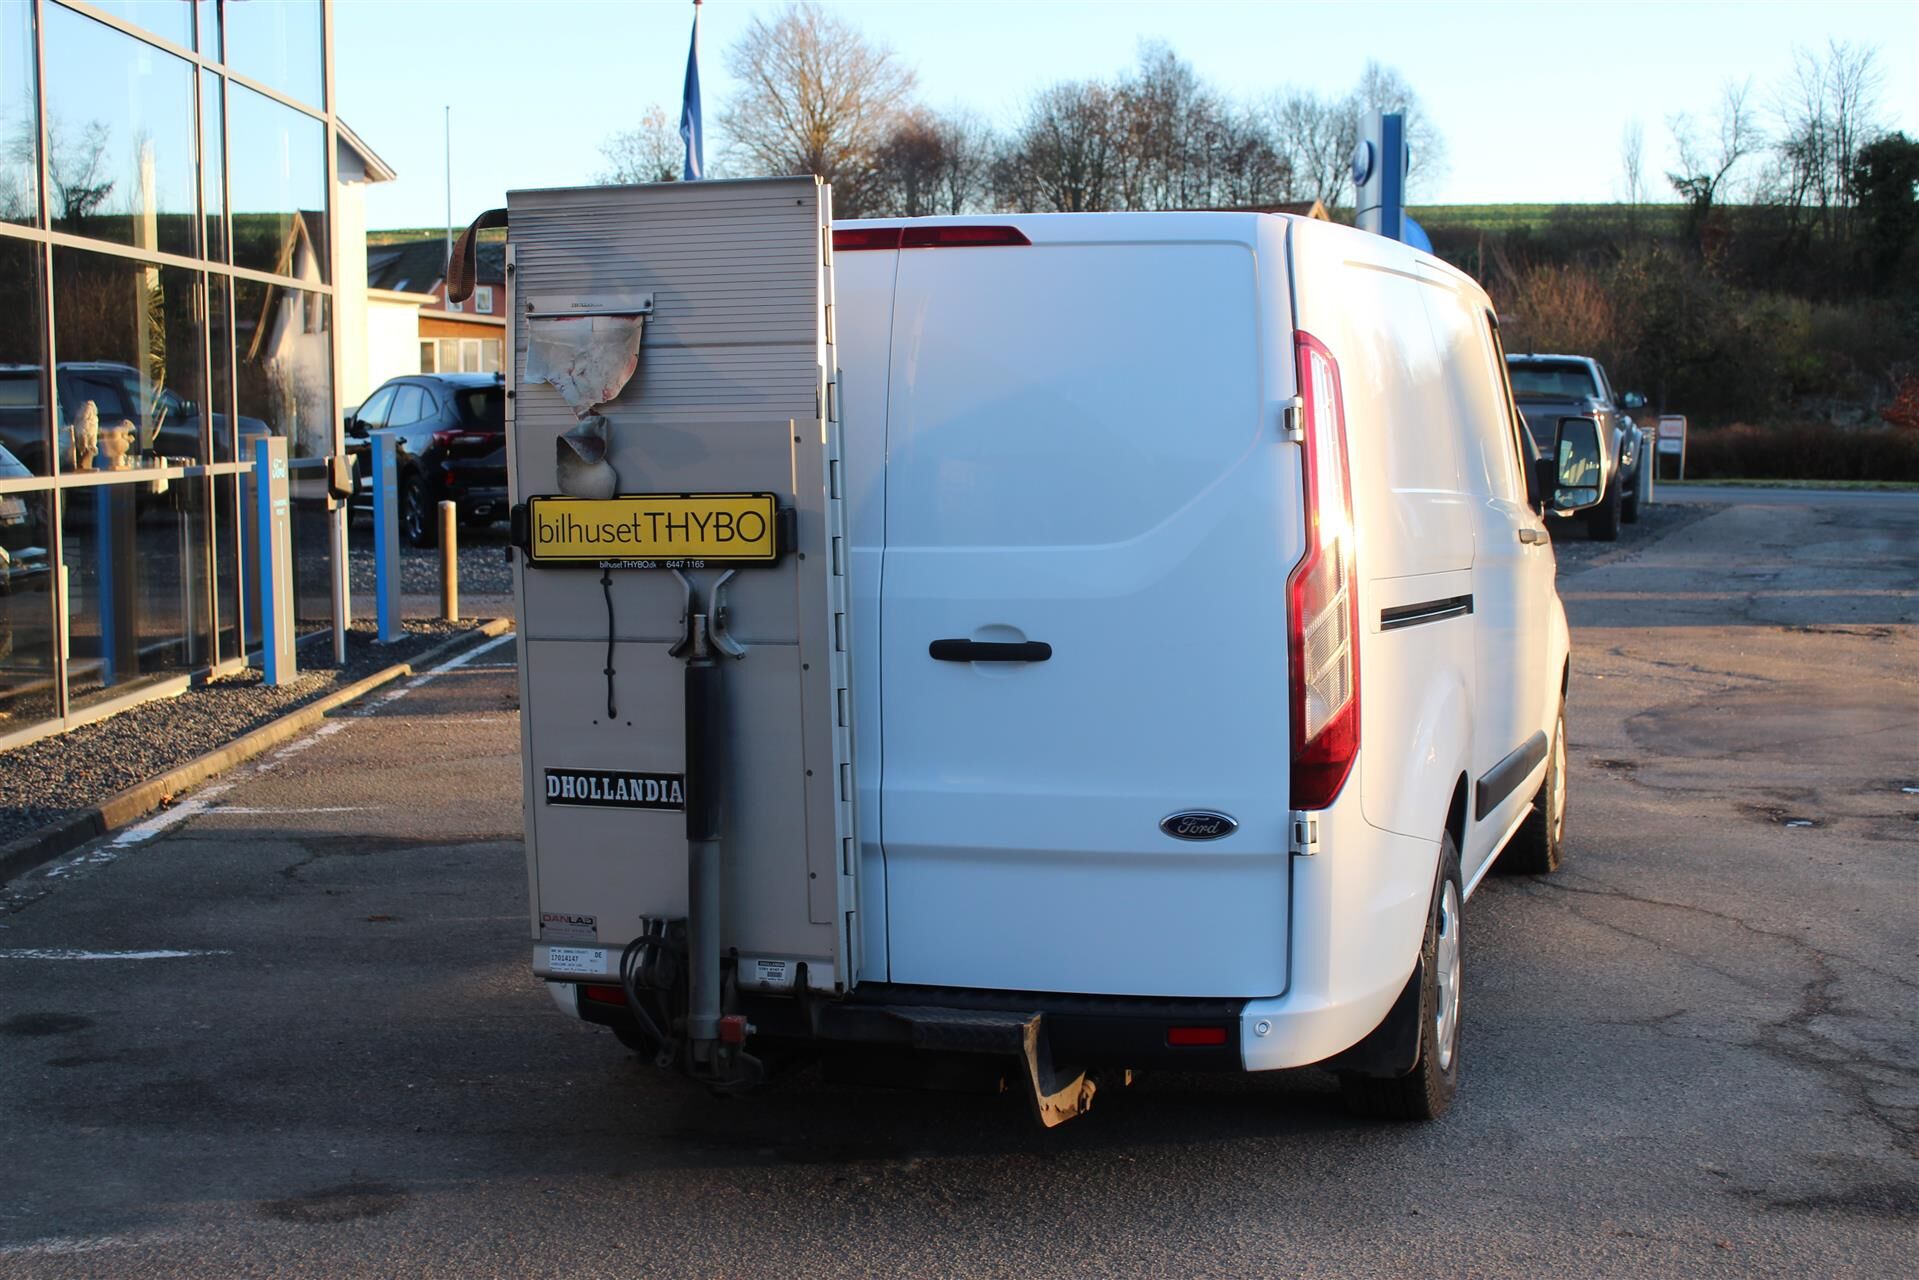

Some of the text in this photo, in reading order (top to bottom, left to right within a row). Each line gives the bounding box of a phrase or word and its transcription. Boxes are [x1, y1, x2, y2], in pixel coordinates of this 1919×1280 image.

[538, 510, 766, 544] bilhusetTHYBO
[666, 560, 684, 569] 6447
[686, 560, 705, 569] 1165
[546, 775, 684, 803] DHOLLANDIA
[1177, 816, 1221, 834] Ford
